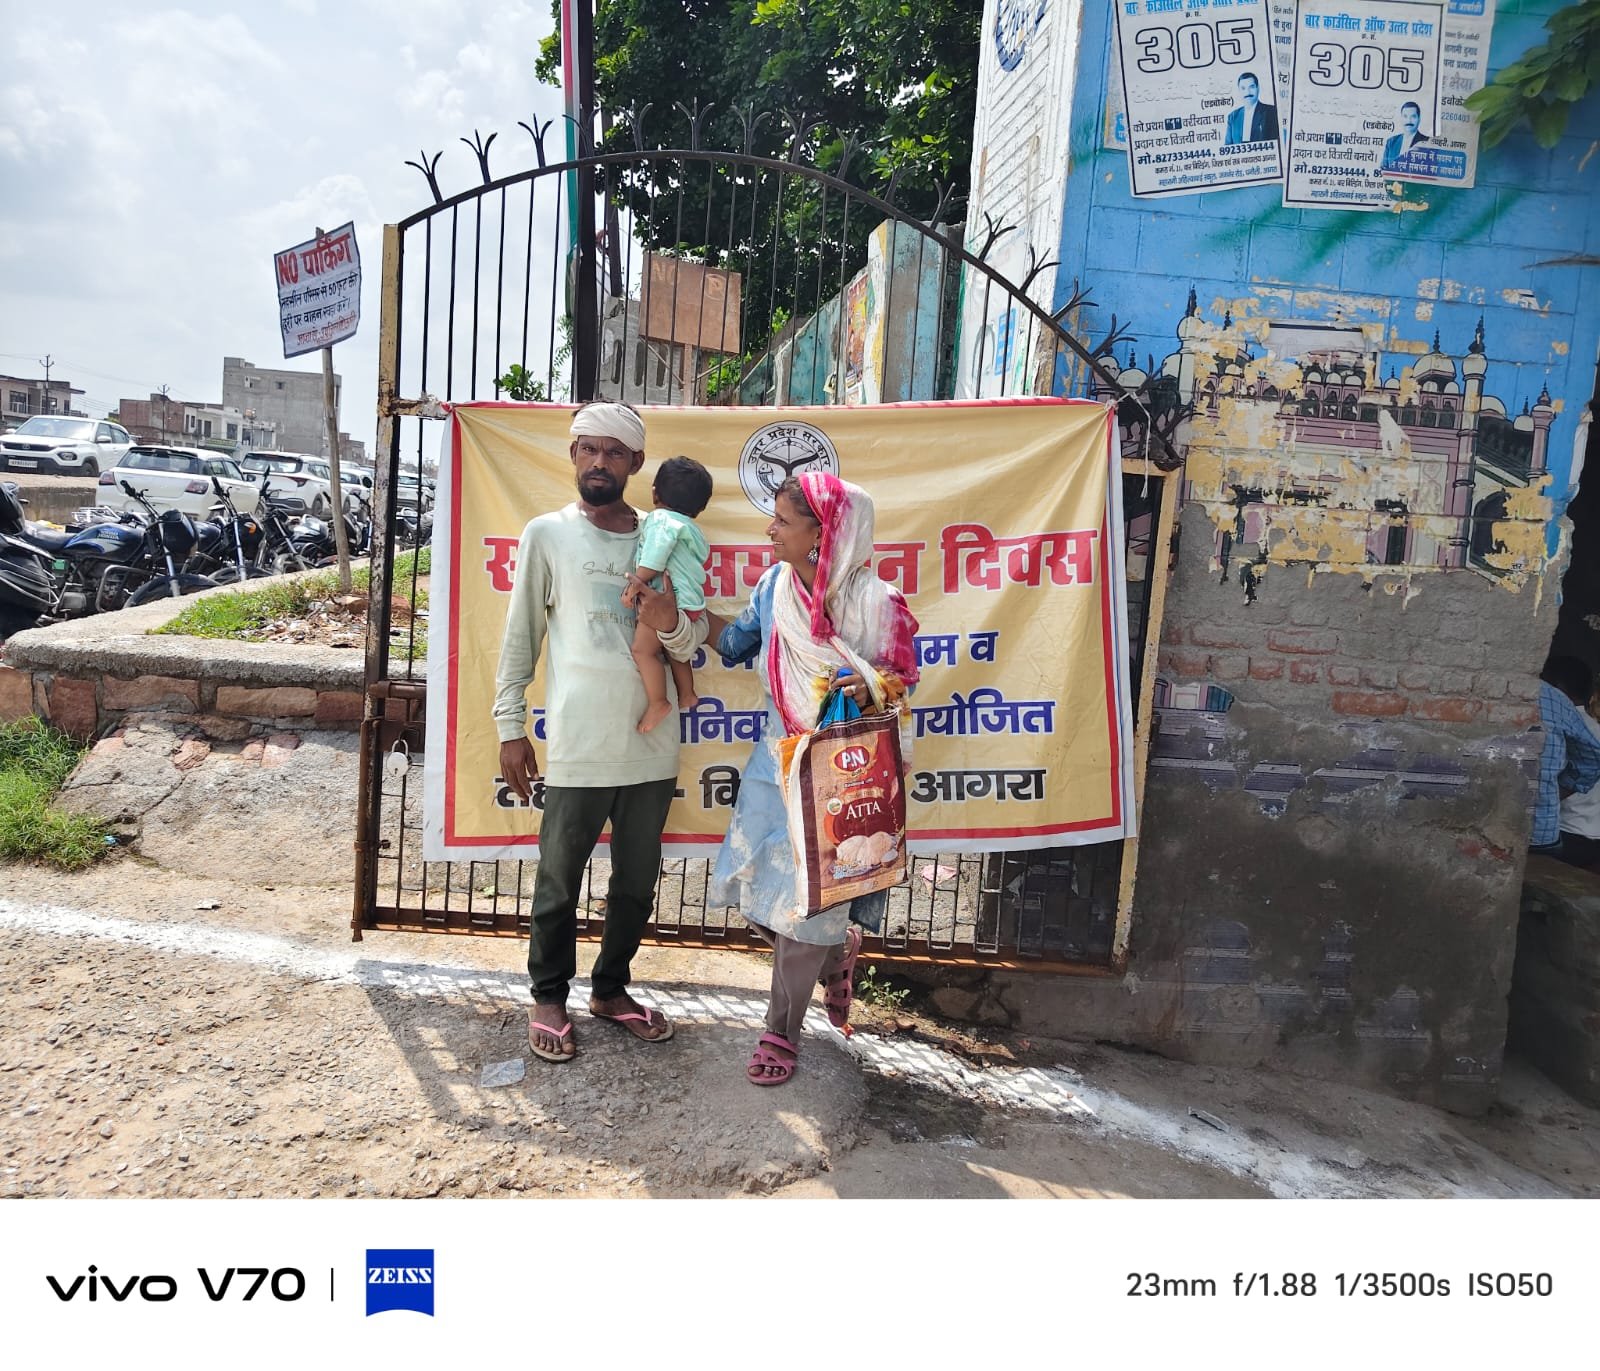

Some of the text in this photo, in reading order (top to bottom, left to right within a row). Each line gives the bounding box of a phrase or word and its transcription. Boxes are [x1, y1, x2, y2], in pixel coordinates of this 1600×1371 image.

[1305, 14, 1320, 29] बार
[1323, 13, 1361, 30] काउंसिल
[1365, 15, 1385, 32] ऑफ
[1388, 20, 1408, 34] उत्तर
[1411, 19, 1433, 37] प्रदेश
[1135, 18, 1256, 73] 305
[1309, 42, 1424, 92] 305
[1133, 120, 1144, 133] को
[1145, 120, 1164, 132] प्रथम
[1182, 113, 1212, 127] वरीयता
[1213, 114, 1225, 124] मत
[1134, 136, 1154, 150] प्रदान
[1155, 135, 1170, 147] कर
[1170, 131, 1195, 146] विजयी
[1295, 129, 1306, 141] को
[1306, 132, 1325, 142] प्रथम
[1343, 132, 1371, 146] वरीयता
[1372, 137, 1384, 146] मत
[1219, 141, 1275, 156] 8923334444
[1293, 148, 1313, 158] प्रदान
[1314, 150, 1327, 159] कर
[1328, 147, 1353, 160] विजयी
[277, 251, 299, 286] NO
[328, 282, 337, 296] 50
[303, 308, 322, 324] वाहन
[766, 426, 798, 440] प्रदेश
[802, 430, 832, 468] सरकार
[940, 522, 1098, 595] दिवस
[910, 768, 1047, 802] आगरा
[846, 800, 882, 820] ATTA
